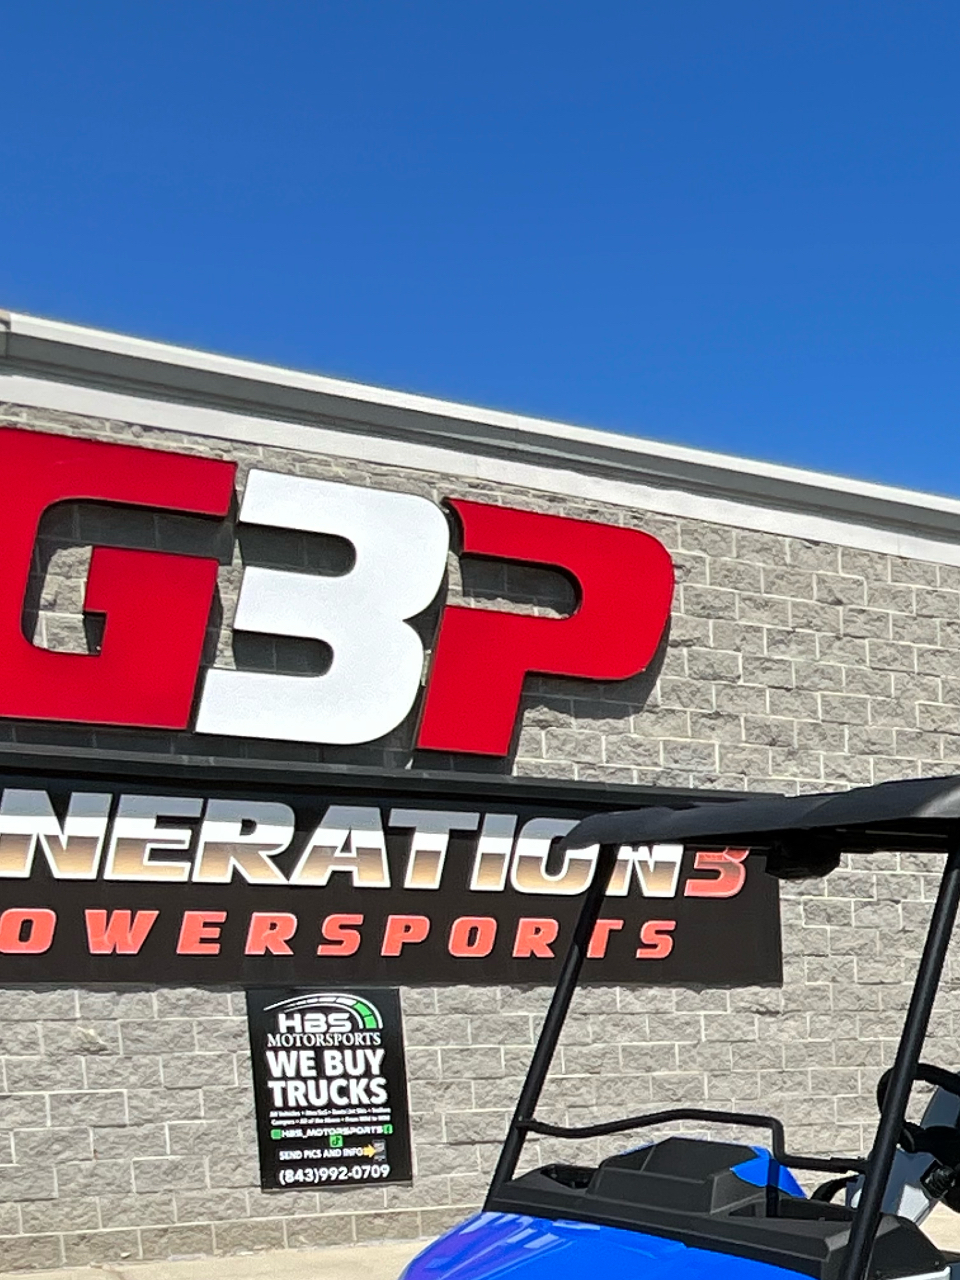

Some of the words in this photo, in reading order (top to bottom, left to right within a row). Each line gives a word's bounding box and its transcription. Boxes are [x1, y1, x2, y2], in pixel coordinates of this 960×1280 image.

[278, 1012, 352, 1033] HBS
[267, 1032, 381, 1048] MOTORSPORTS
[266, 1050, 318, 1078] WE
[323, 1048, 385, 1077] BUY
[267, 1076, 389, 1108] TRUCKS
[279, 1149, 303, 1161] SEND
[303, 1149, 322, 1160] PICS
[323, 1148, 342, 1158] AND
[343, 1146, 364, 1157] INFO
[278, 1163, 390, 1186] (843)992-0709
